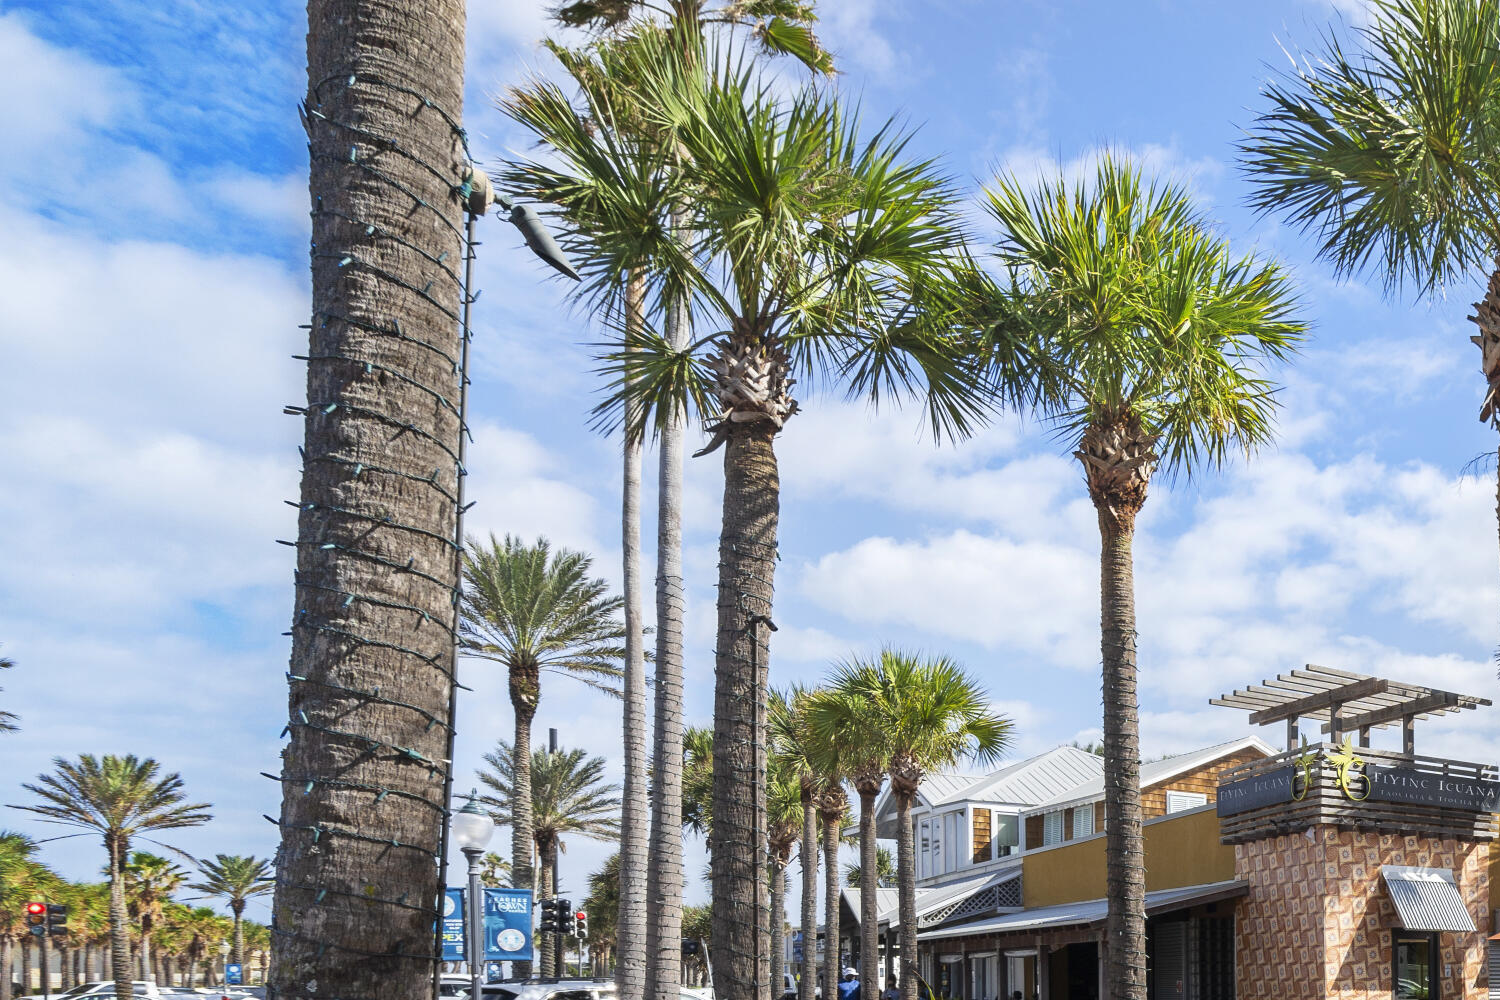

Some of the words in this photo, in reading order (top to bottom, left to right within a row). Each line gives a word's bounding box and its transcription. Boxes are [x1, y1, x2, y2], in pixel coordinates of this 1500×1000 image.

[1374, 771, 1430, 789] FLYING
[1439, 780, 1495, 798] IGUANA
[491, 901, 528, 913] TOWN
